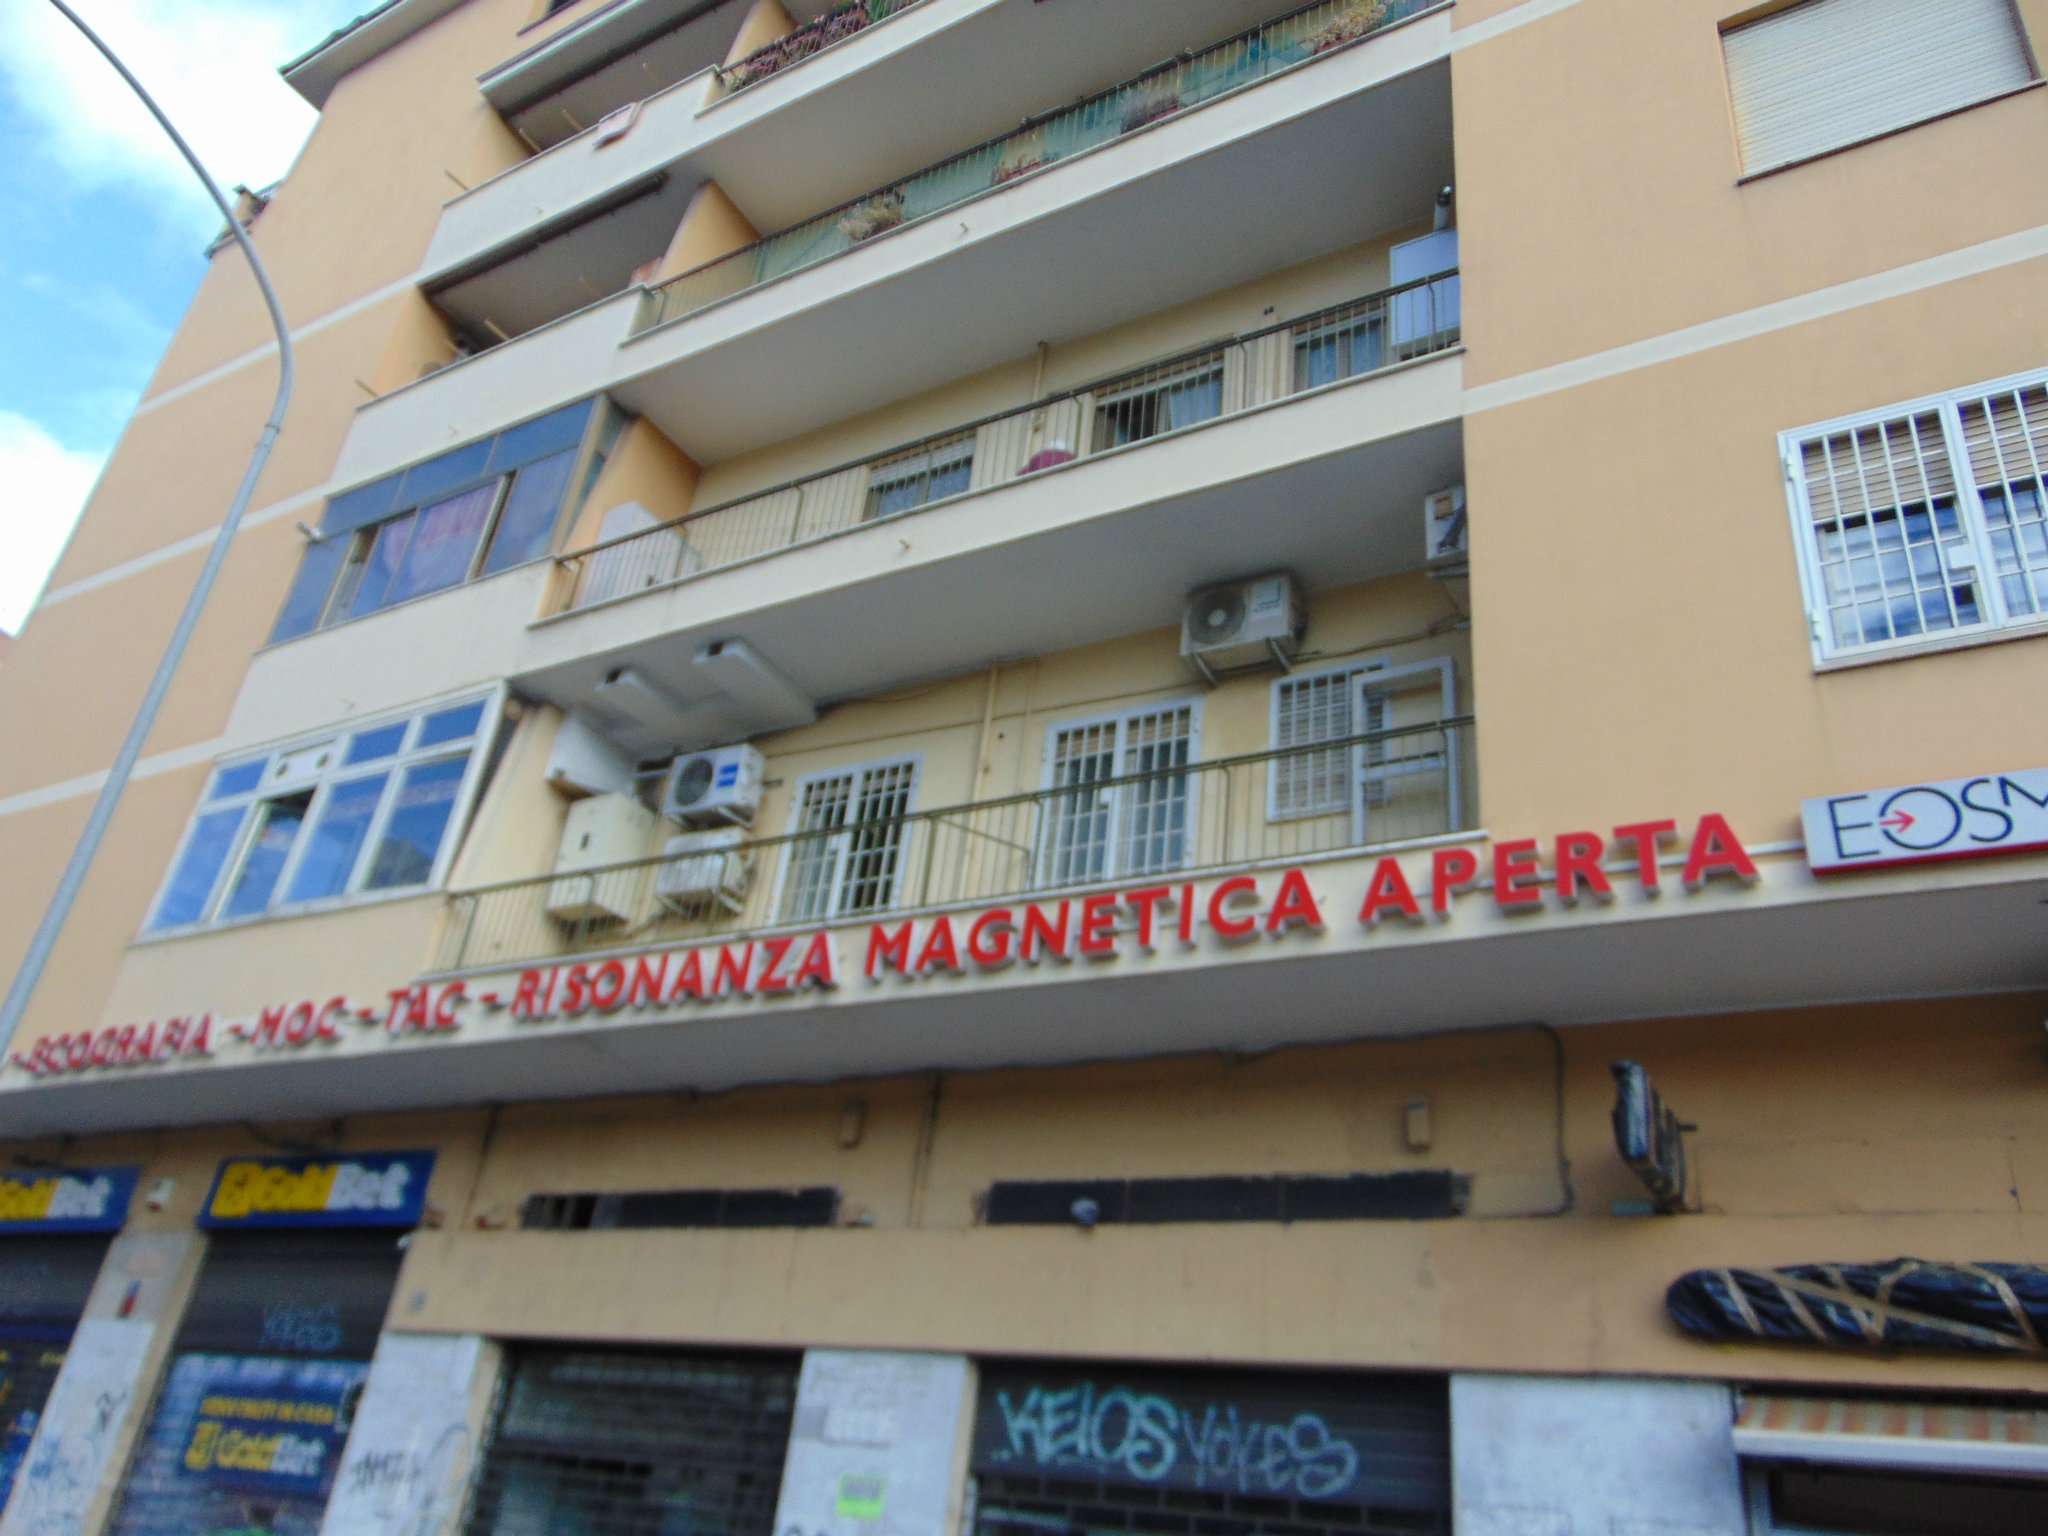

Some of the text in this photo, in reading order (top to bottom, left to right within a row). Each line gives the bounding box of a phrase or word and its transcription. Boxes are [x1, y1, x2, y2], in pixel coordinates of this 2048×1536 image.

[249, 996, 347, 1048] MOC
[384, 979, 470, 1035] TAC
[510, 928, 837, 1023] RISONANZA
[864, 867, 1325, 982] MAGNETICA
[1359, 812, 1760, 925] APERTA
